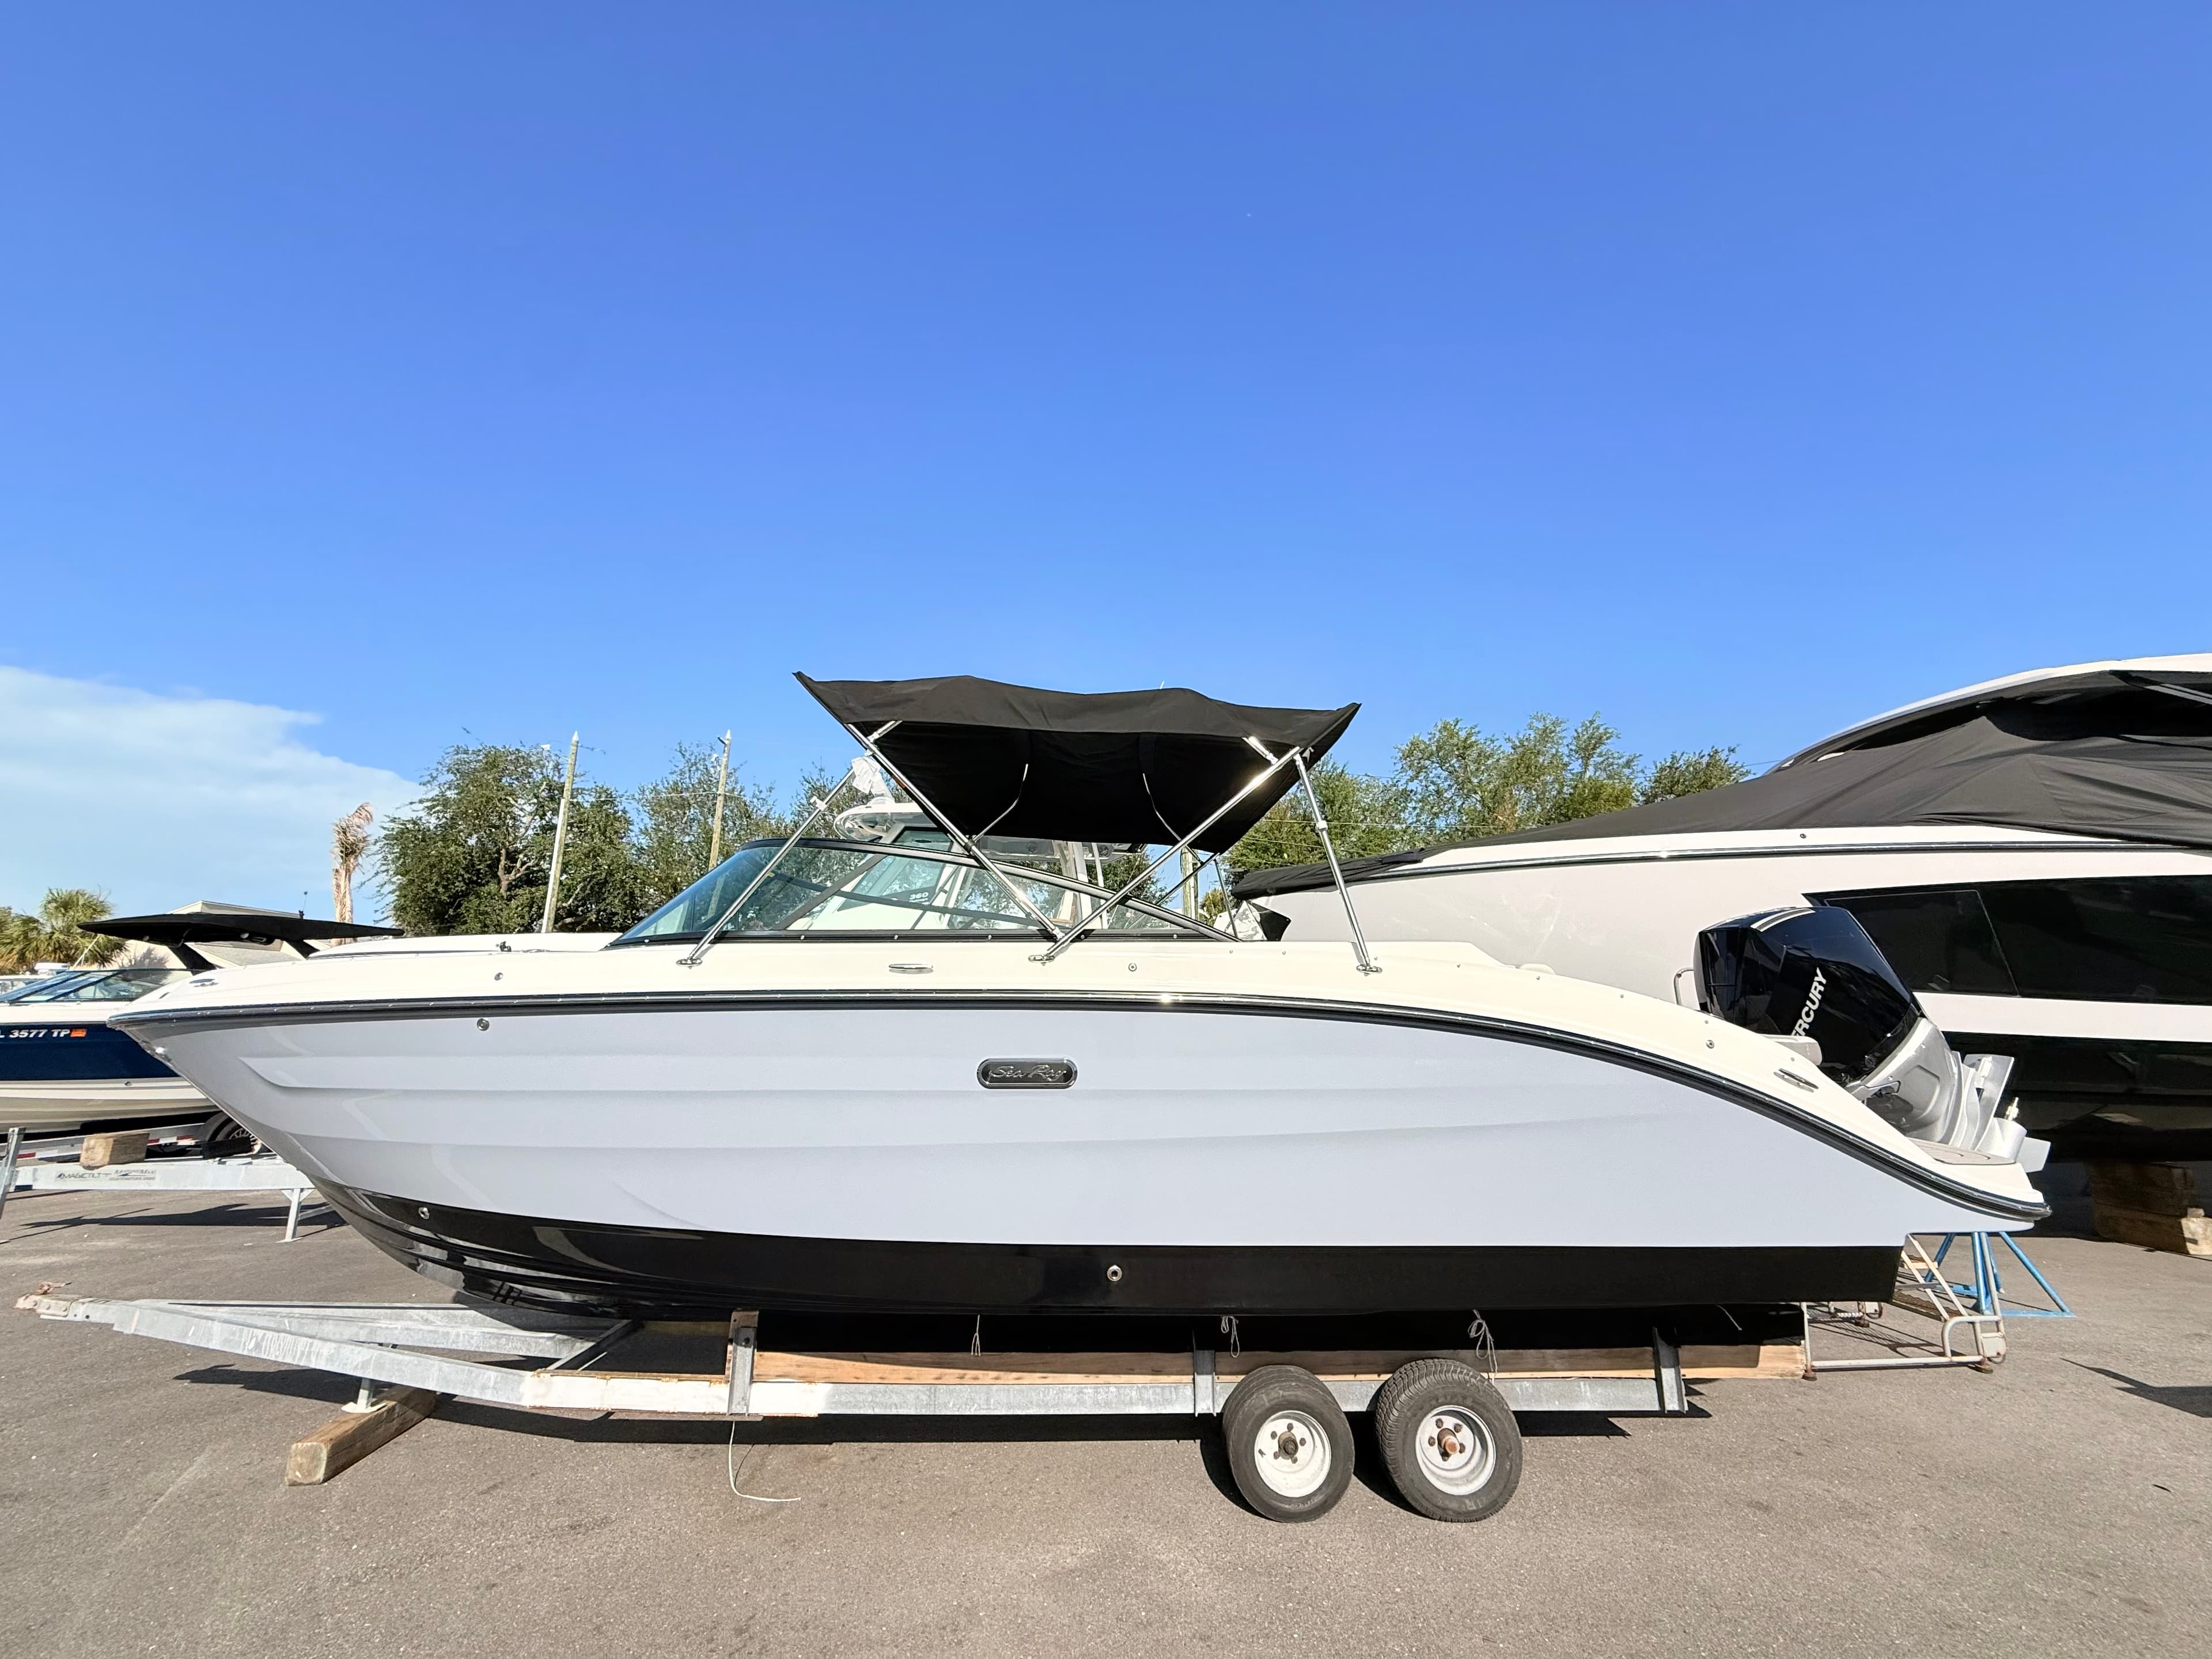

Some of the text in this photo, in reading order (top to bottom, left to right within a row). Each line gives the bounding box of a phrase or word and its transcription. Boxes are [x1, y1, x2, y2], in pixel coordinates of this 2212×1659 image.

[909, 892, 929, 900] 360
[1791, 967, 1827, 1036] RCURY
[9, 1029, 48, 1038] 3577
[51, 1029, 70, 1037] TP
[988, 1065, 1067, 1081] Sea Ray
